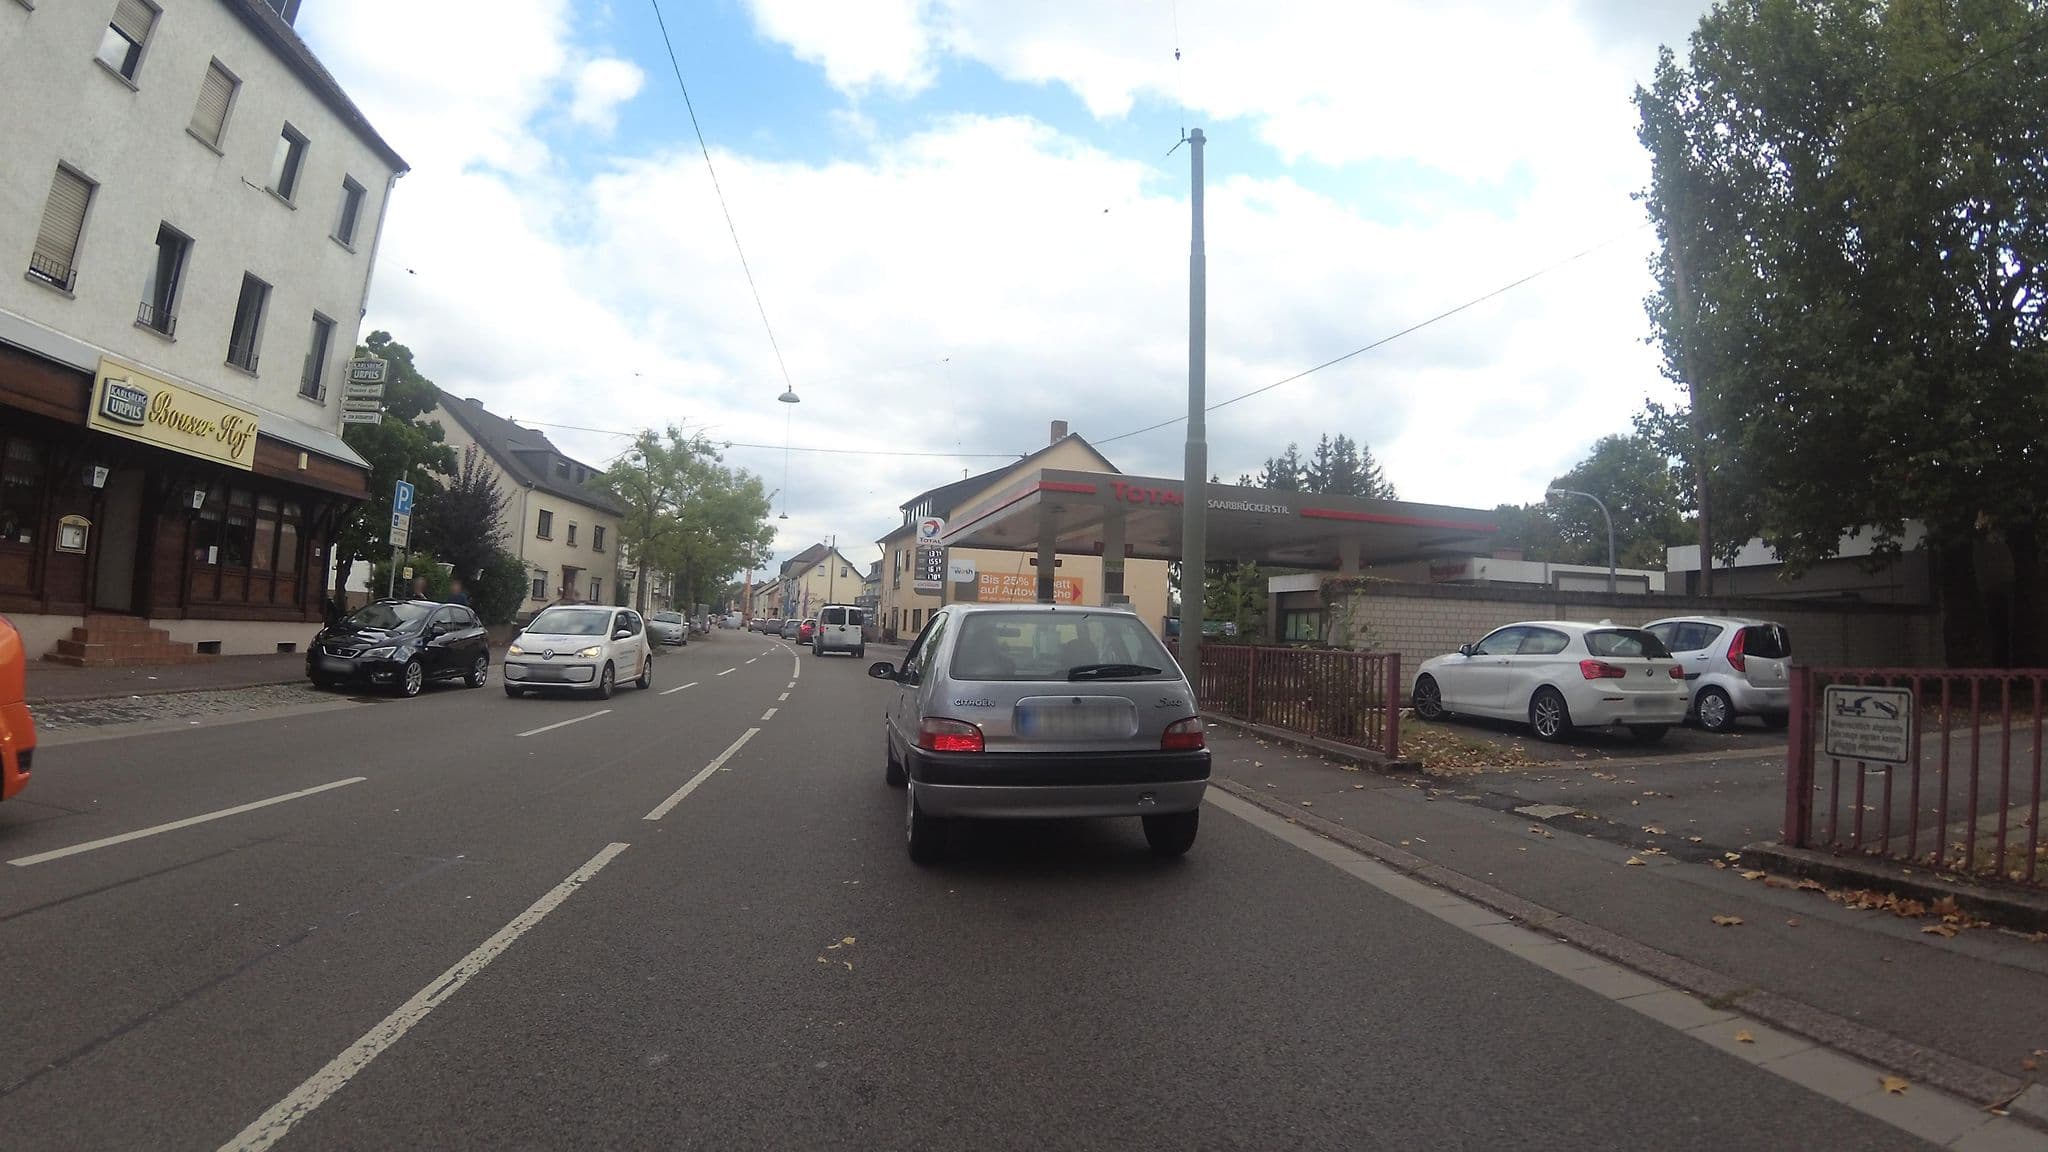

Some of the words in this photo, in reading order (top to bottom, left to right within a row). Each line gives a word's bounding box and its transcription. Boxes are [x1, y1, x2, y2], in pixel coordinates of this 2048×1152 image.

[353, 369, 380, 379] URPILS
[110, 384, 148, 405] KARLSBERG
[110, 399, 143, 420] URPILS
[217, 413, 257, 460] Hof
[398, 486, 409, 509] P
[1109, 480, 1184, 506] TOTA
[1207, 499, 1271, 513] SAARBRÜCKER
[1271, 504, 1290, 515] STR.
[981, 574, 1000, 585] Bis
[1003, 575, 1030, 586] 25%
[980, 585, 999, 594] auf
[1002, 588, 1071, 599] Autowche
